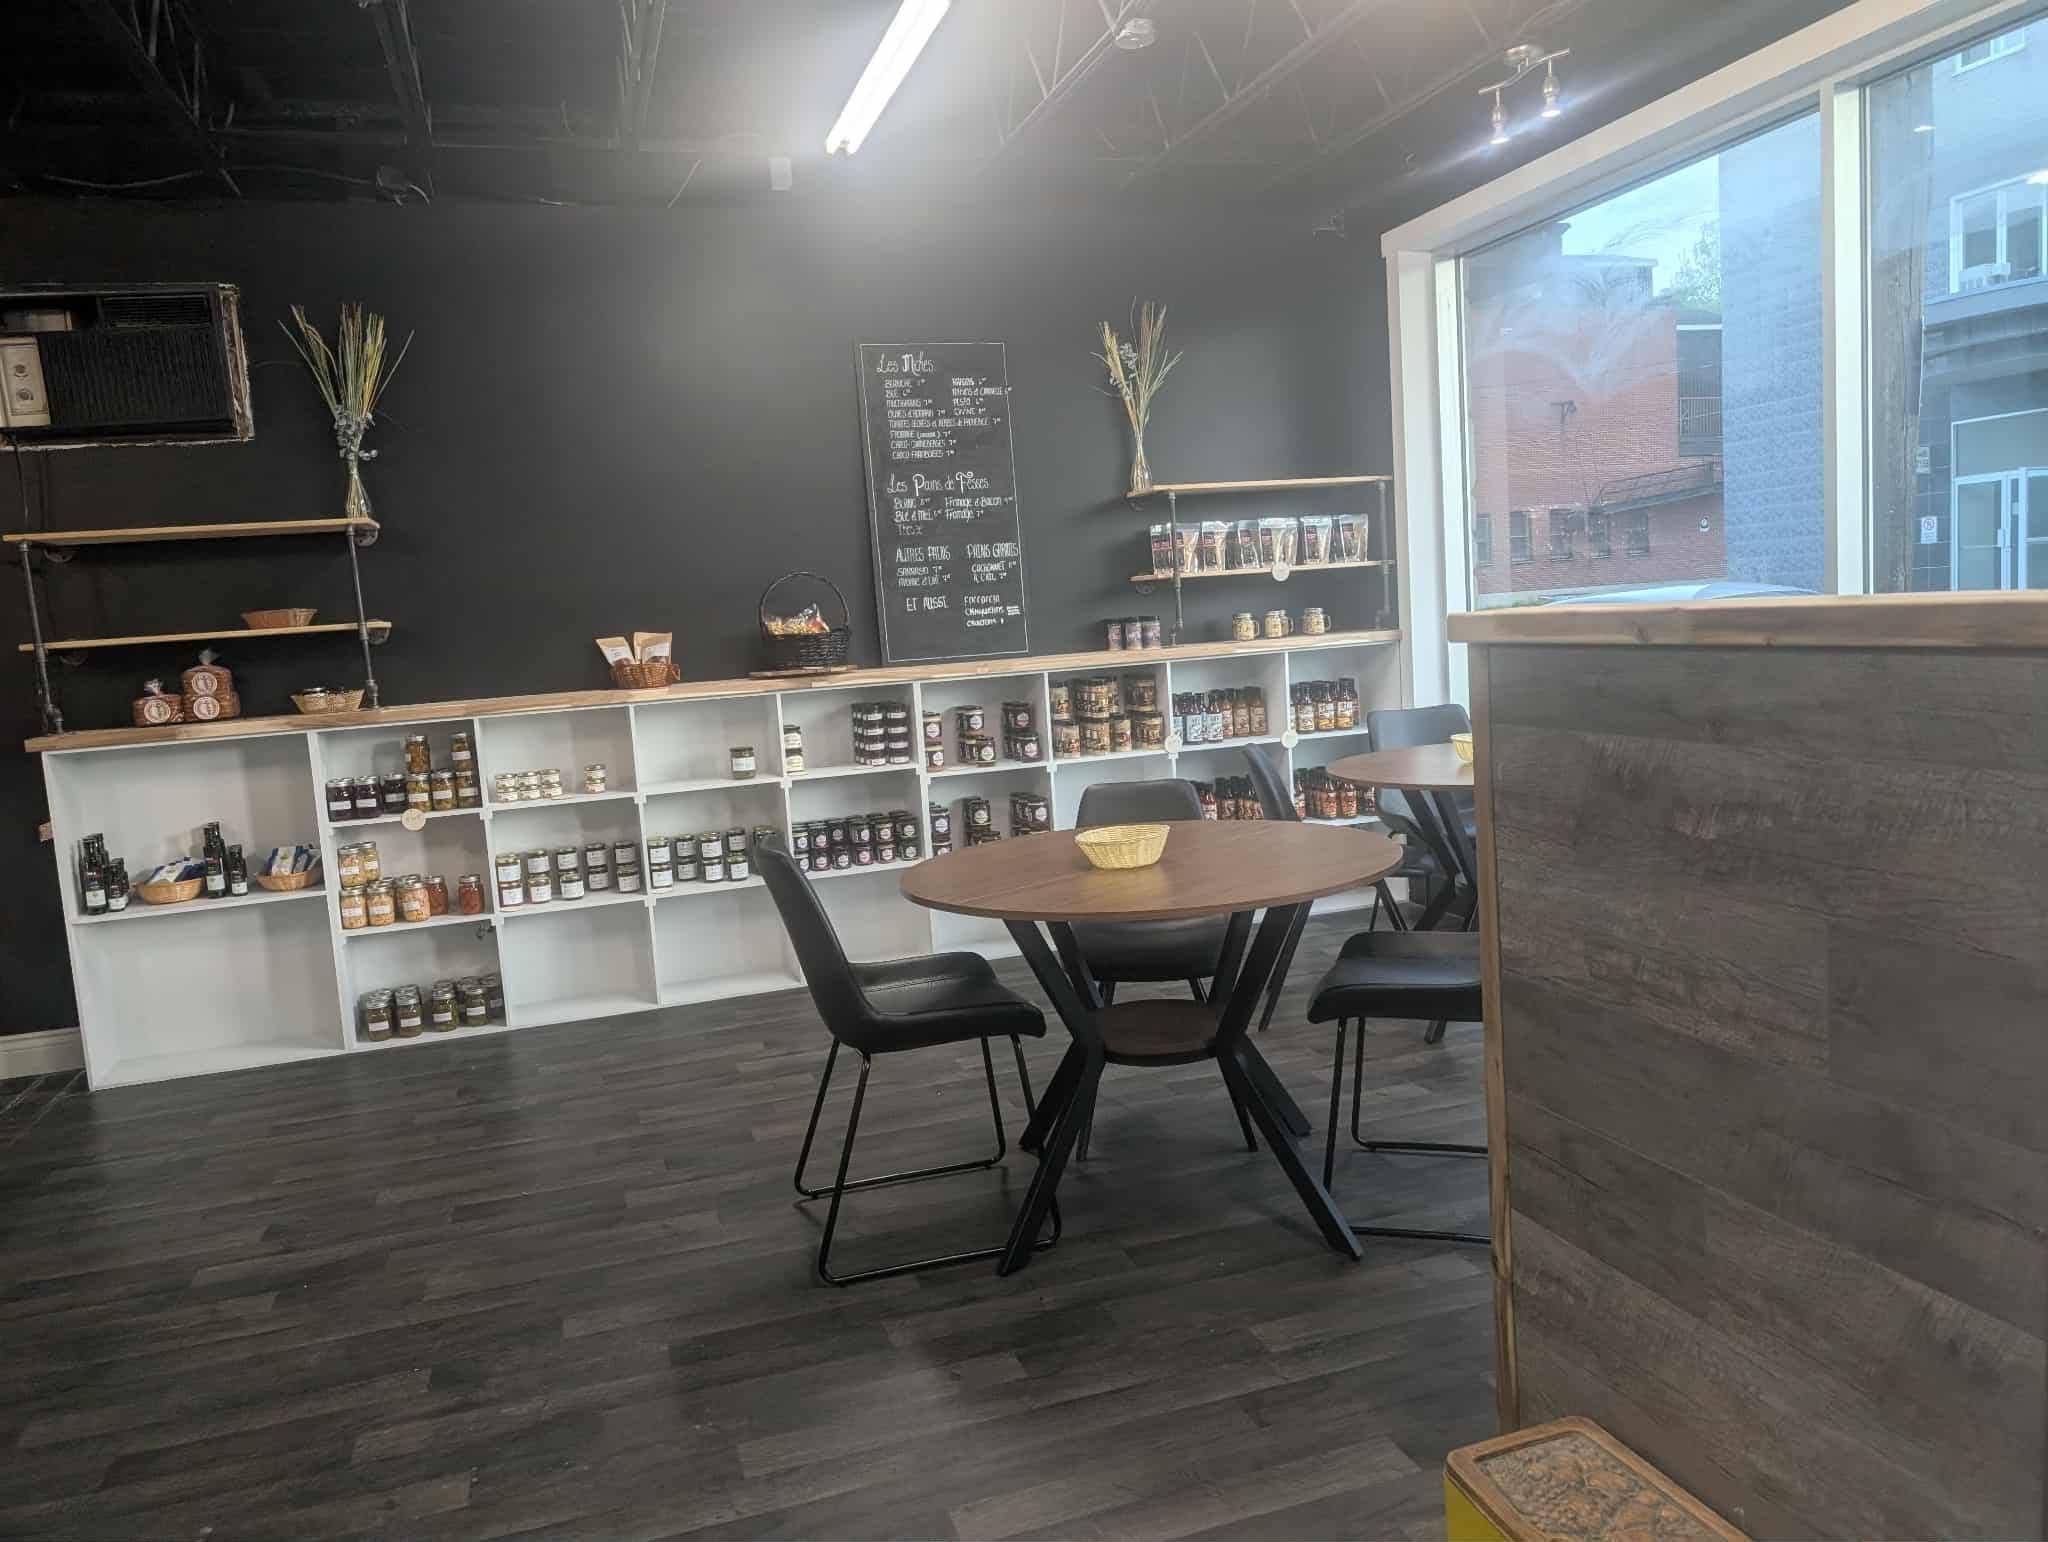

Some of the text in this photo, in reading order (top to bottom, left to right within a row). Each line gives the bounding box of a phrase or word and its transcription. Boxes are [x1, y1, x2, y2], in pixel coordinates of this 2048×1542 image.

[877, 353, 899, 373] Les
[887, 473, 908, 493] Les
[896, 545, 951, 562] AUTRES PAINS
[967, 543, 990, 559] PAINS
[906, 598, 918, 611] ET
